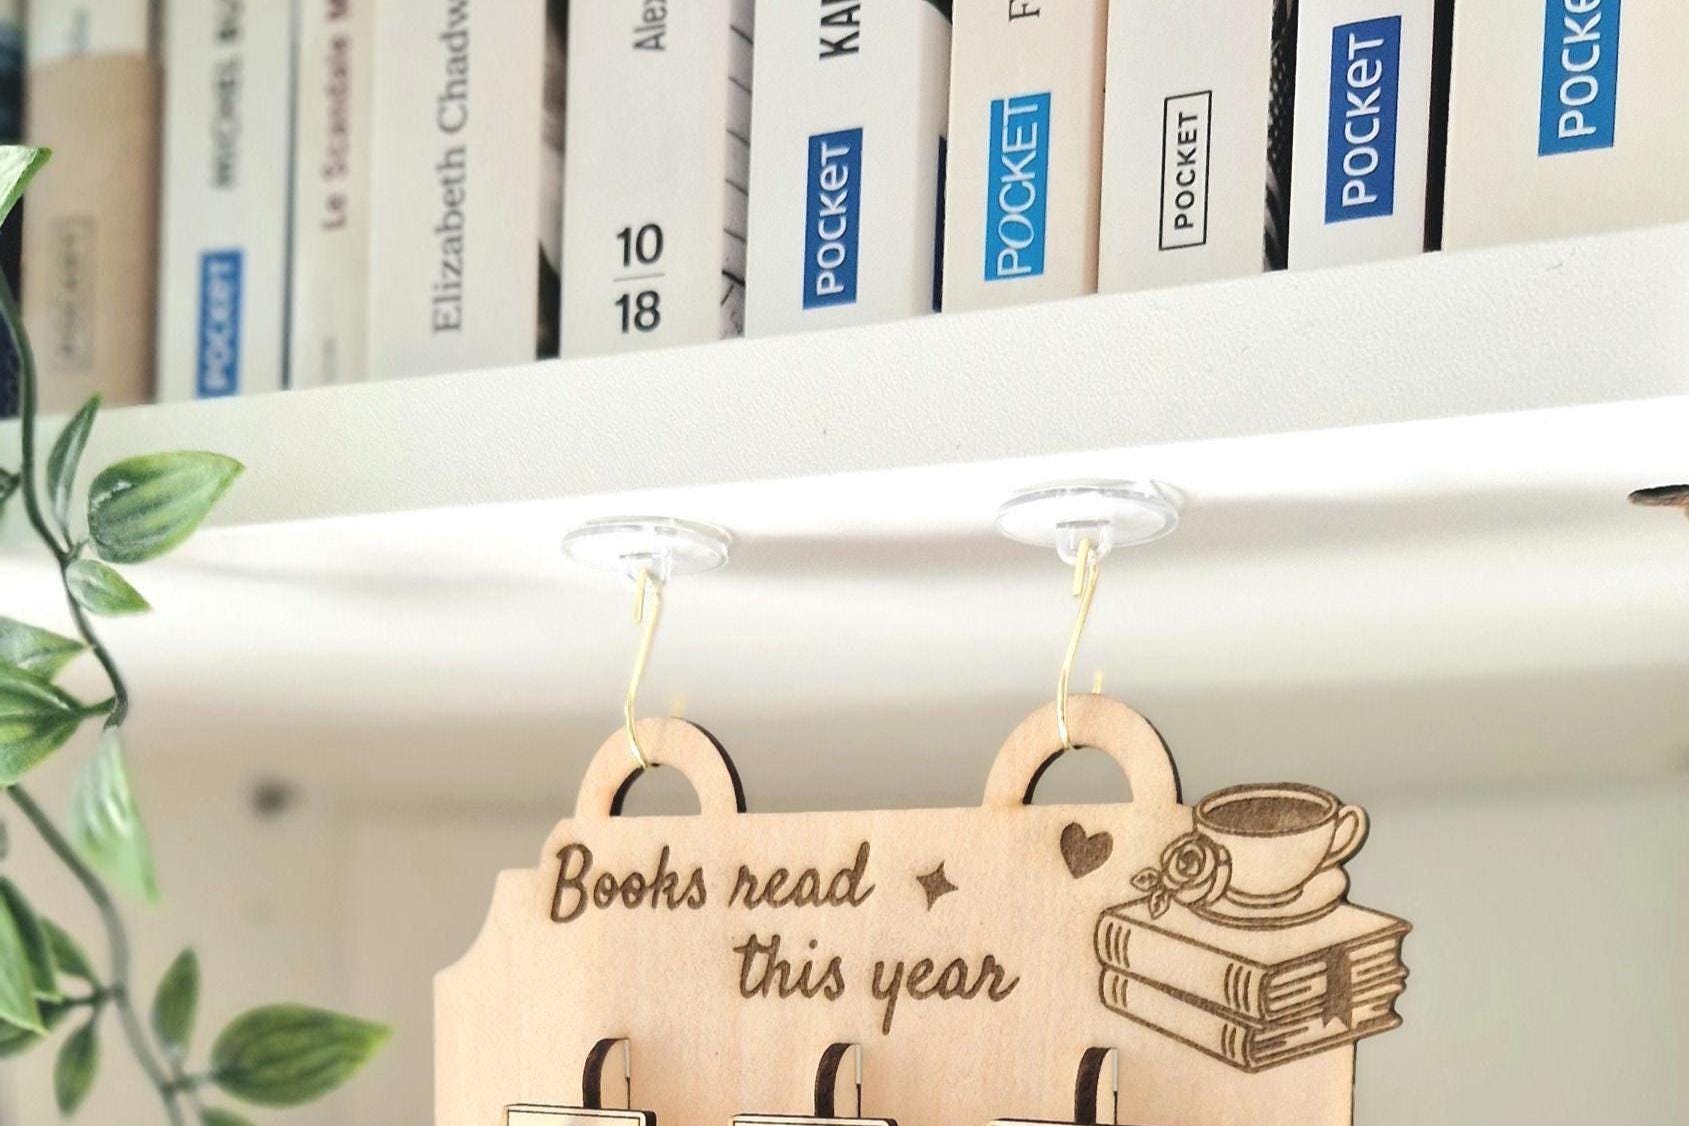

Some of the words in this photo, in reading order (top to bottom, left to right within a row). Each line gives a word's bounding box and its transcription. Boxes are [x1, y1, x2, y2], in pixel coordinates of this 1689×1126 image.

[997, 97, 1039, 278] POCKET
[1174, 111, 1199, 230] POCKET
[432, 146, 467, 334] Elizabeth
[617, 223, 664, 267] 10
[615, 290, 661, 333] 18
[550, 843, 707, 924] Books
[727, 840, 876, 910] read
[732, 933, 846, 1001] this
[871, 953, 1021, 1036] year
